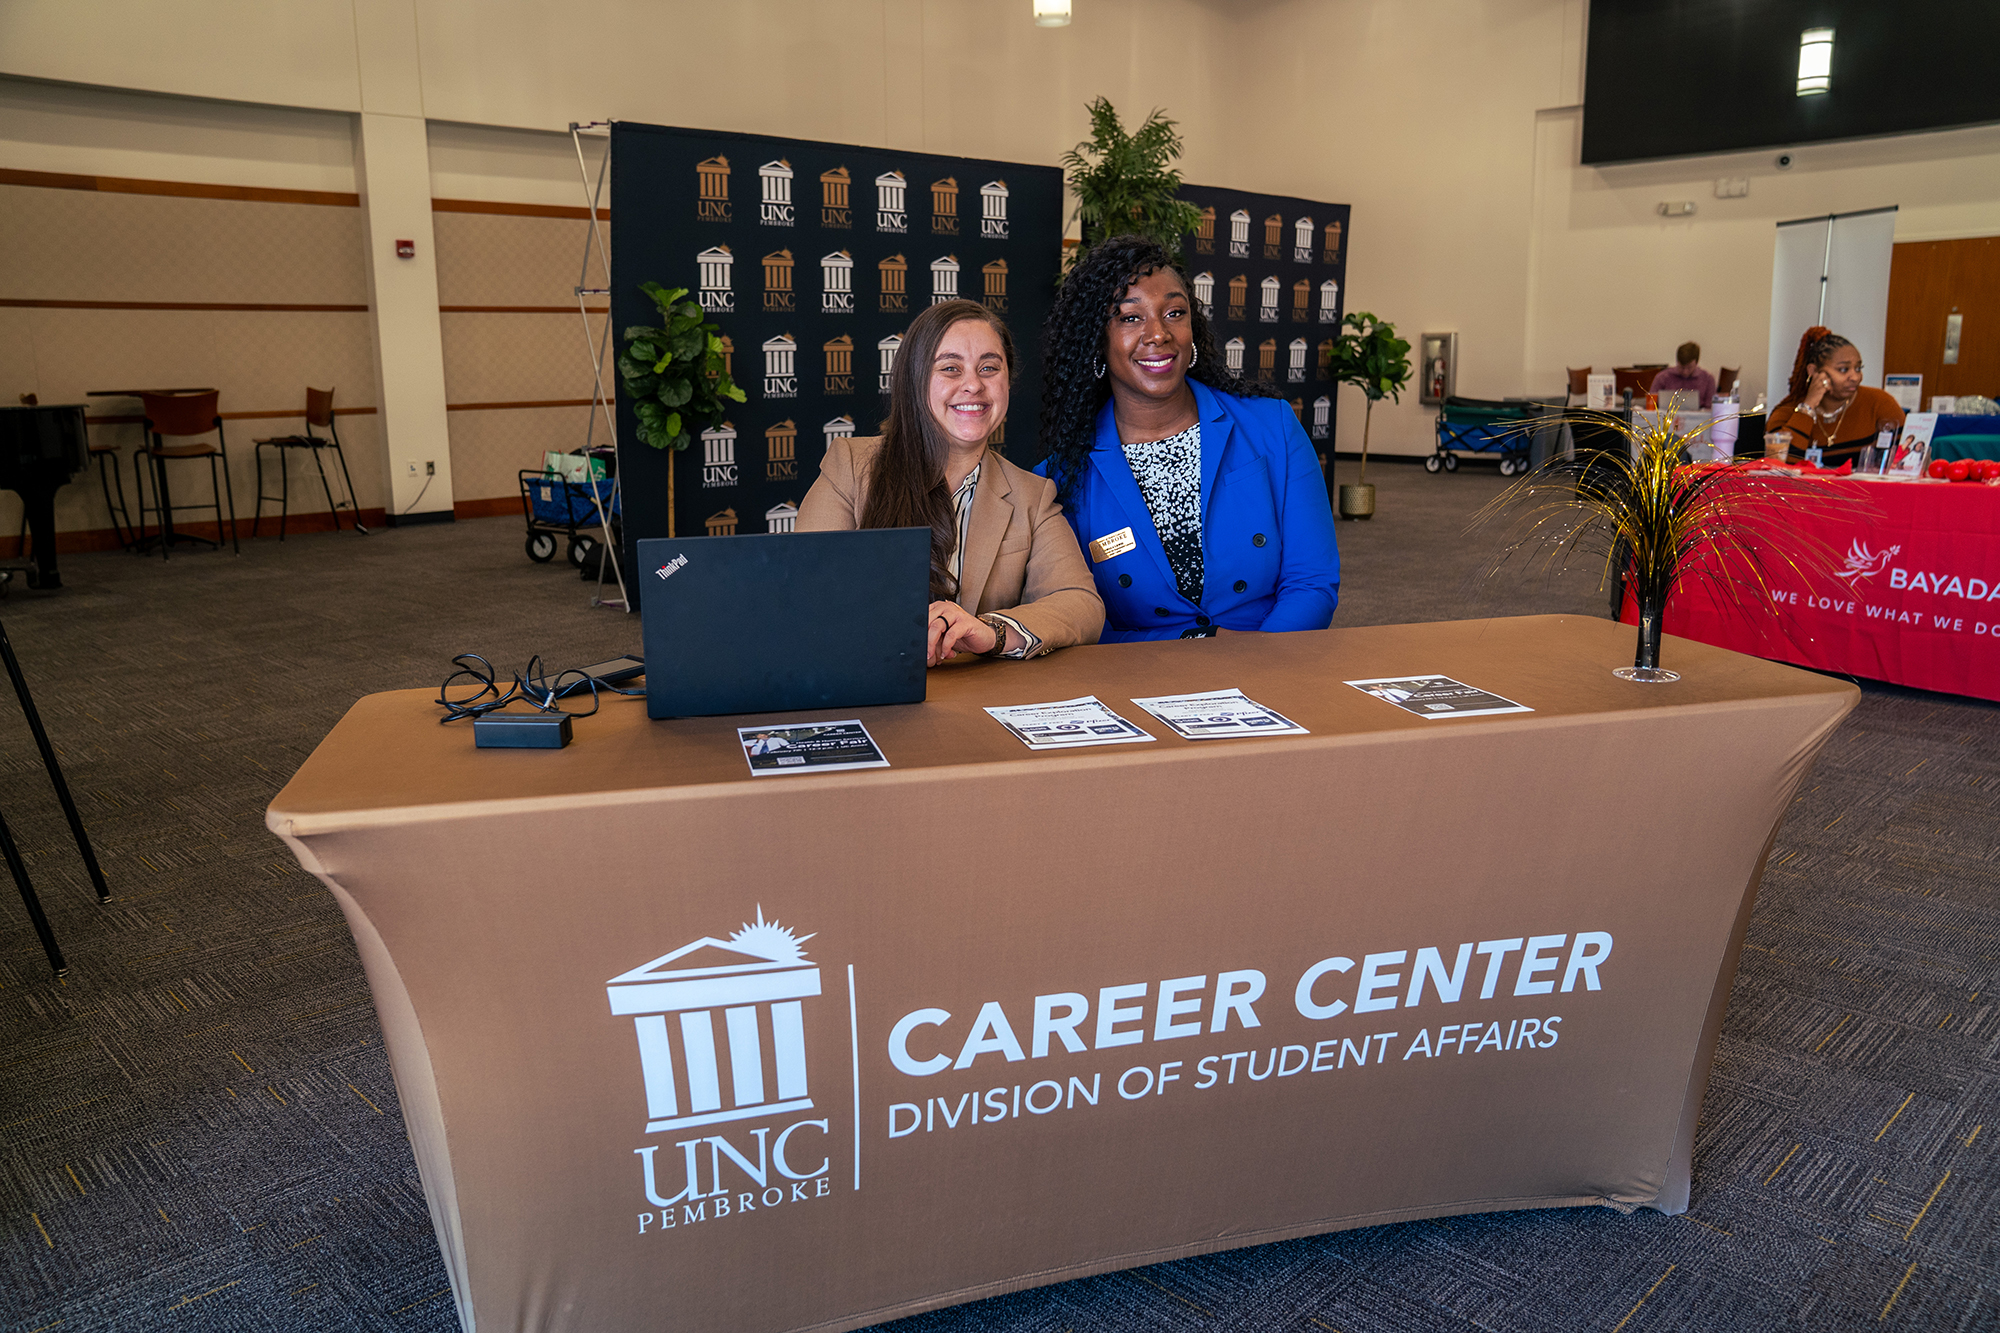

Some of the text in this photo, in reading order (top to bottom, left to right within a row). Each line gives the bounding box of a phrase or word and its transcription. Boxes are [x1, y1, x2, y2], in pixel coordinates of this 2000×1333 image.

[698, 201, 732, 217] UNC
[760, 204, 794, 222] UNC
[821, 209, 852, 224] UNC
[876, 212, 908, 228] UNC
[932, 216, 959, 231] UNC
[981, 220, 1008, 234] UNC
[1230, 242, 1250, 254] UNC
[1294, 248, 1313, 260] UNC
[698, 292, 734, 308] UNC
[763, 292, 796, 307] UNC
[822, 294, 854, 308] UNC
[880, 295, 908, 308] UNC
[983, 296, 1008, 310] UNC
[1260, 308, 1279, 319] UNC
[1320, 310, 1336, 320] UNC
[1288, 368, 1306, 380] UNC
[764, 378, 798, 394] UNC
[824, 376, 854, 390] UNC
[1312, 425, 1330, 436] UNC
[703, 466, 738, 482] UNC
[766, 462, 798, 477] UNC
[655, 553, 688, 580] ThinkPad
[1890, 568, 2000, 602] BAYADA
[1772, 589, 2000, 637] WE LOVE WHAT WE DO
[888, 931, 1614, 1076] CAREER CENTER
[888, 1016, 1562, 1138] DIVISION OF STUDENT AFFAIRS
[634, 1118, 829, 1208] UNC
[638, 1177, 830, 1234] PEMBROKE
